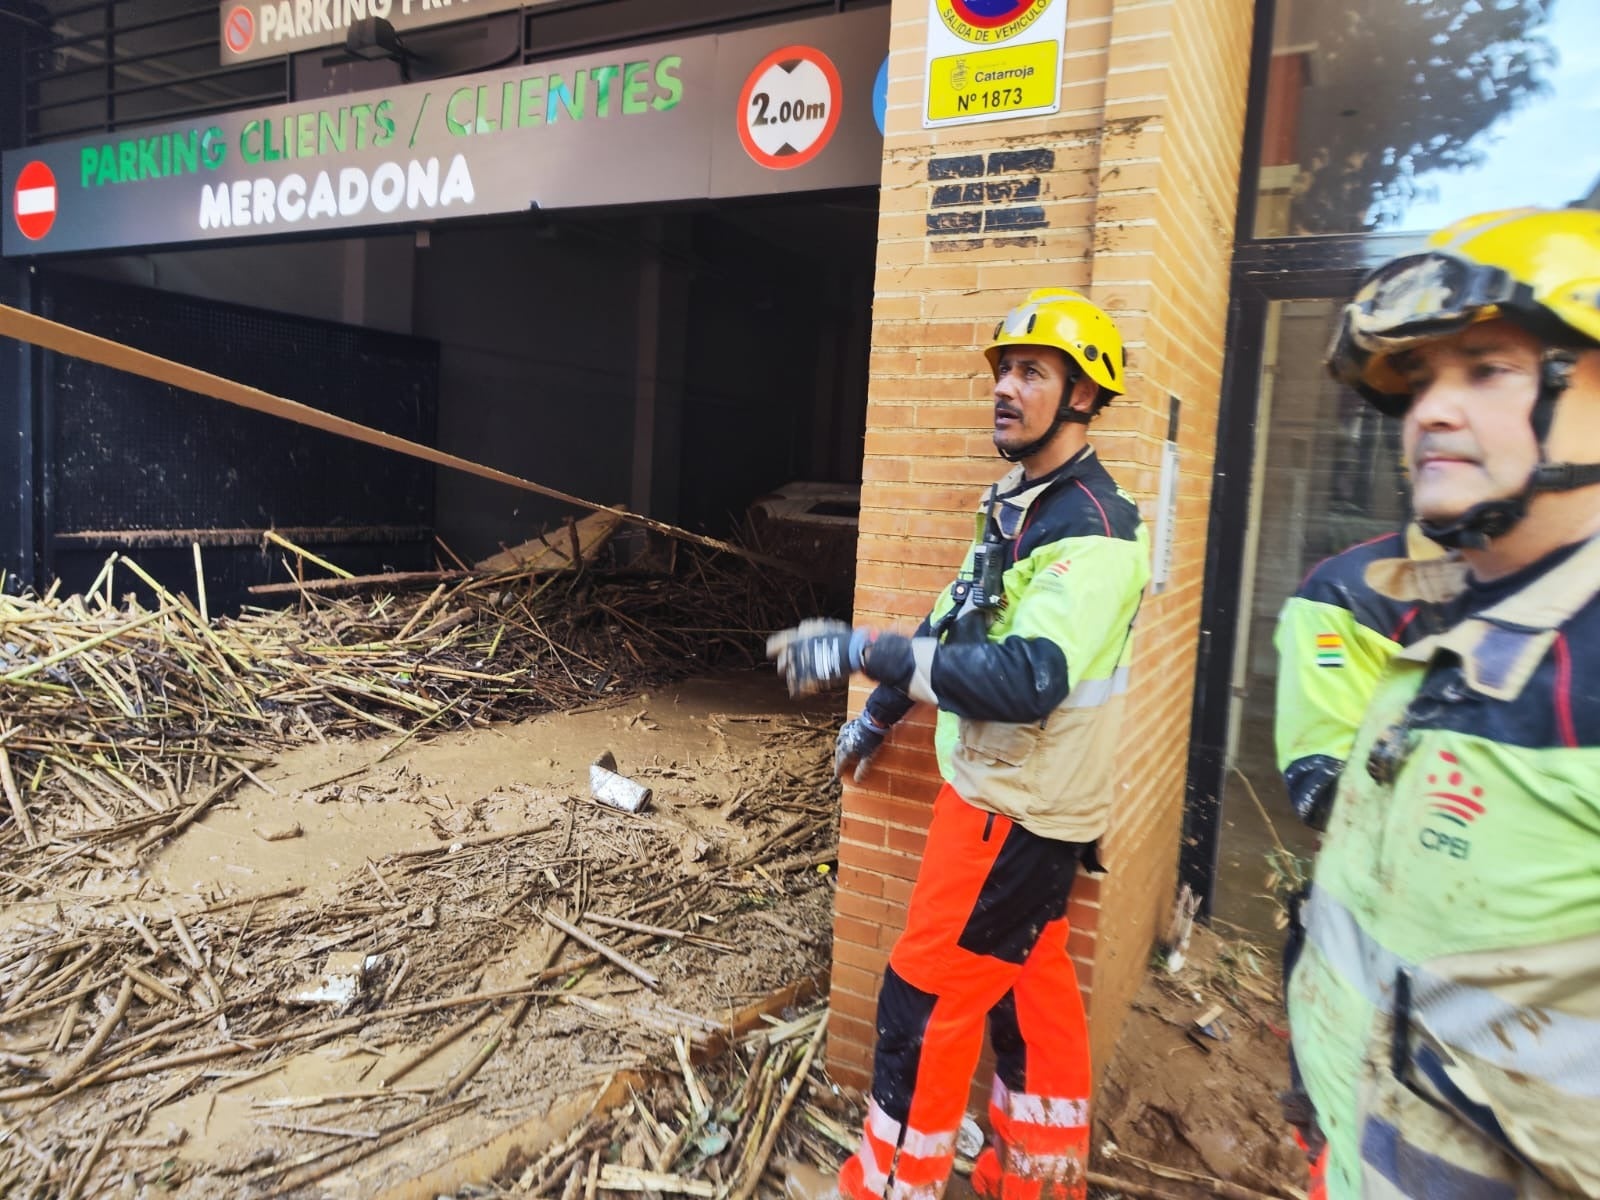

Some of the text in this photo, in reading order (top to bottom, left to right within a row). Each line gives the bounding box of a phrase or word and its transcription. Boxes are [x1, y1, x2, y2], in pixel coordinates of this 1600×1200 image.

[260, 0, 392, 44] PARKING
[943, 8, 972, 39] SALIDA
[974, 30, 989, 41] DE
[974, 65, 1035, 83] Catarroja
[752, 92, 826, 127] 2.00m
[957, 87, 1023, 112] Nº 1873
[81, 55, 684, 188] PARKING CLIENTS / CLIENTES
[199, 154, 475, 229] MERCADONA
